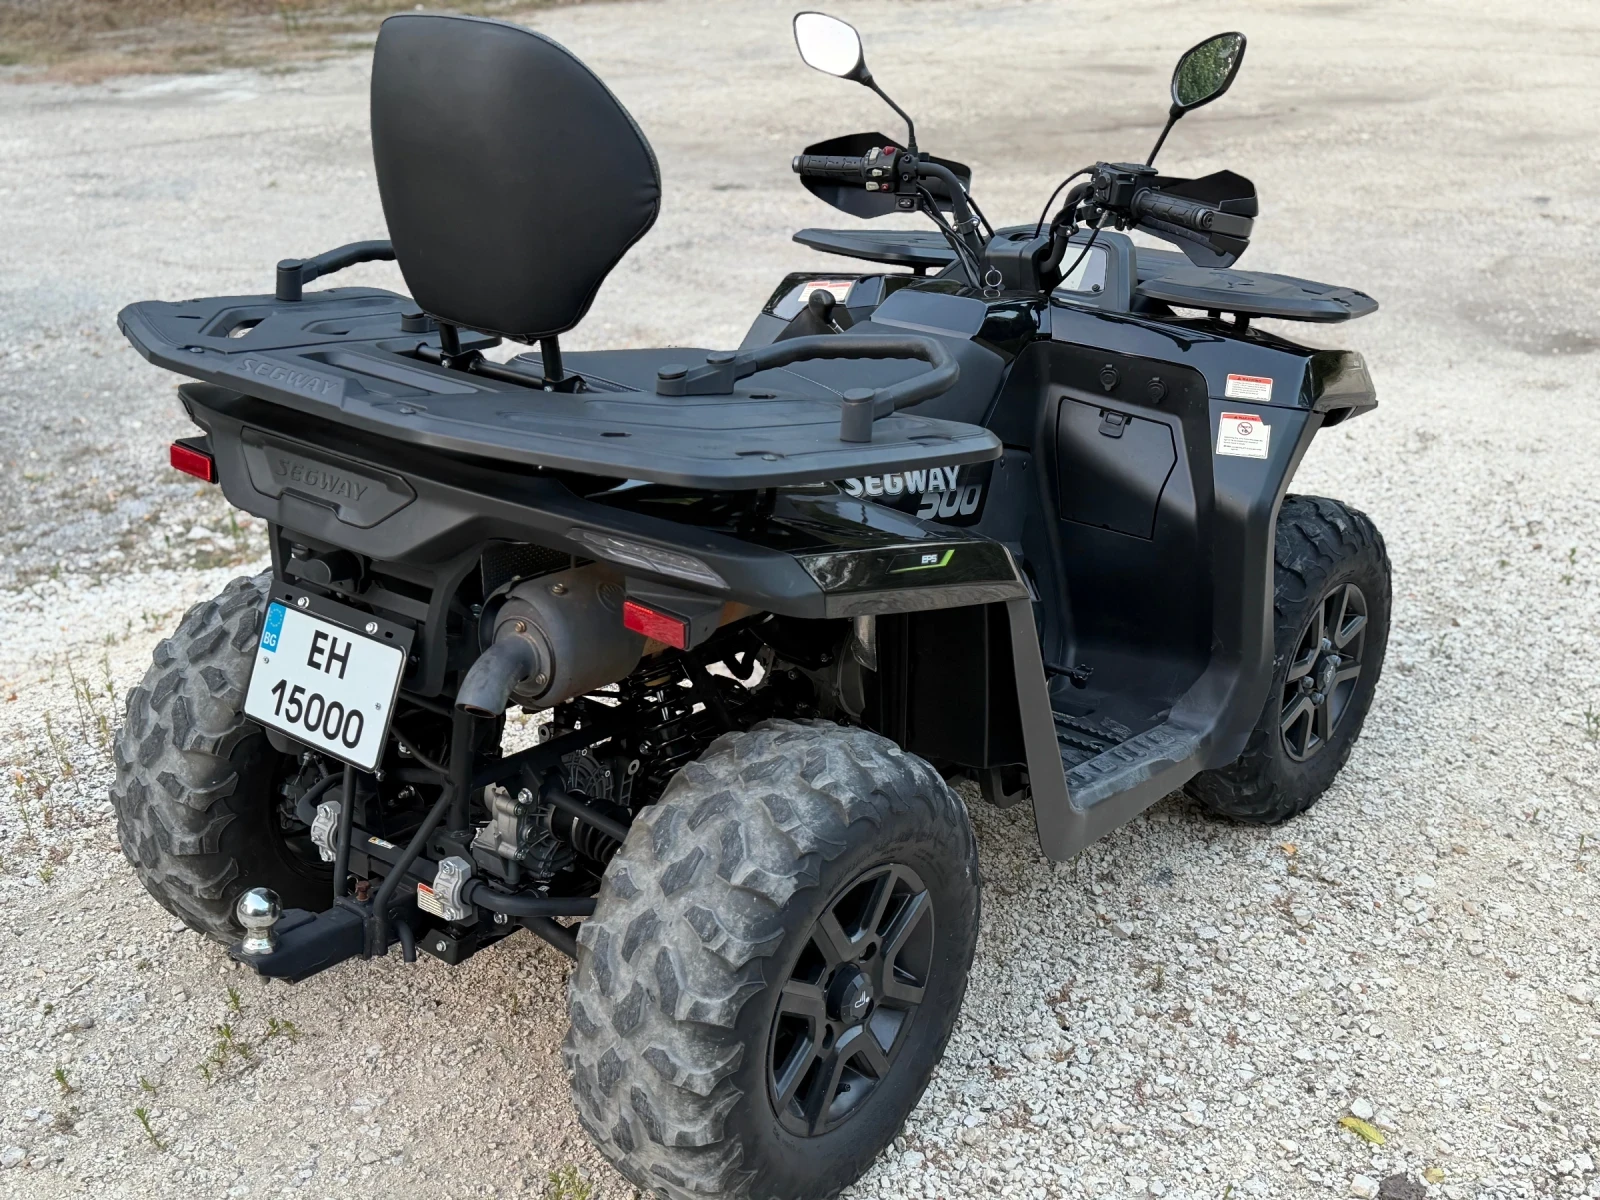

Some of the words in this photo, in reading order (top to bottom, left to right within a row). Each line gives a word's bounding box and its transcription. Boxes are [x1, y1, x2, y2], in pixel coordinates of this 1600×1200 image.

[237, 358, 338, 395] SEGWAY
[275, 459, 369, 501] SEGWAY
[844, 465, 960, 498] SEGWAY
[915, 484, 983, 520] 500
[921, 554, 938, 564] EPS
[263, 631, 277, 647] BG
[306, 629, 353, 680] EH
[271, 678, 365, 749] 15000
